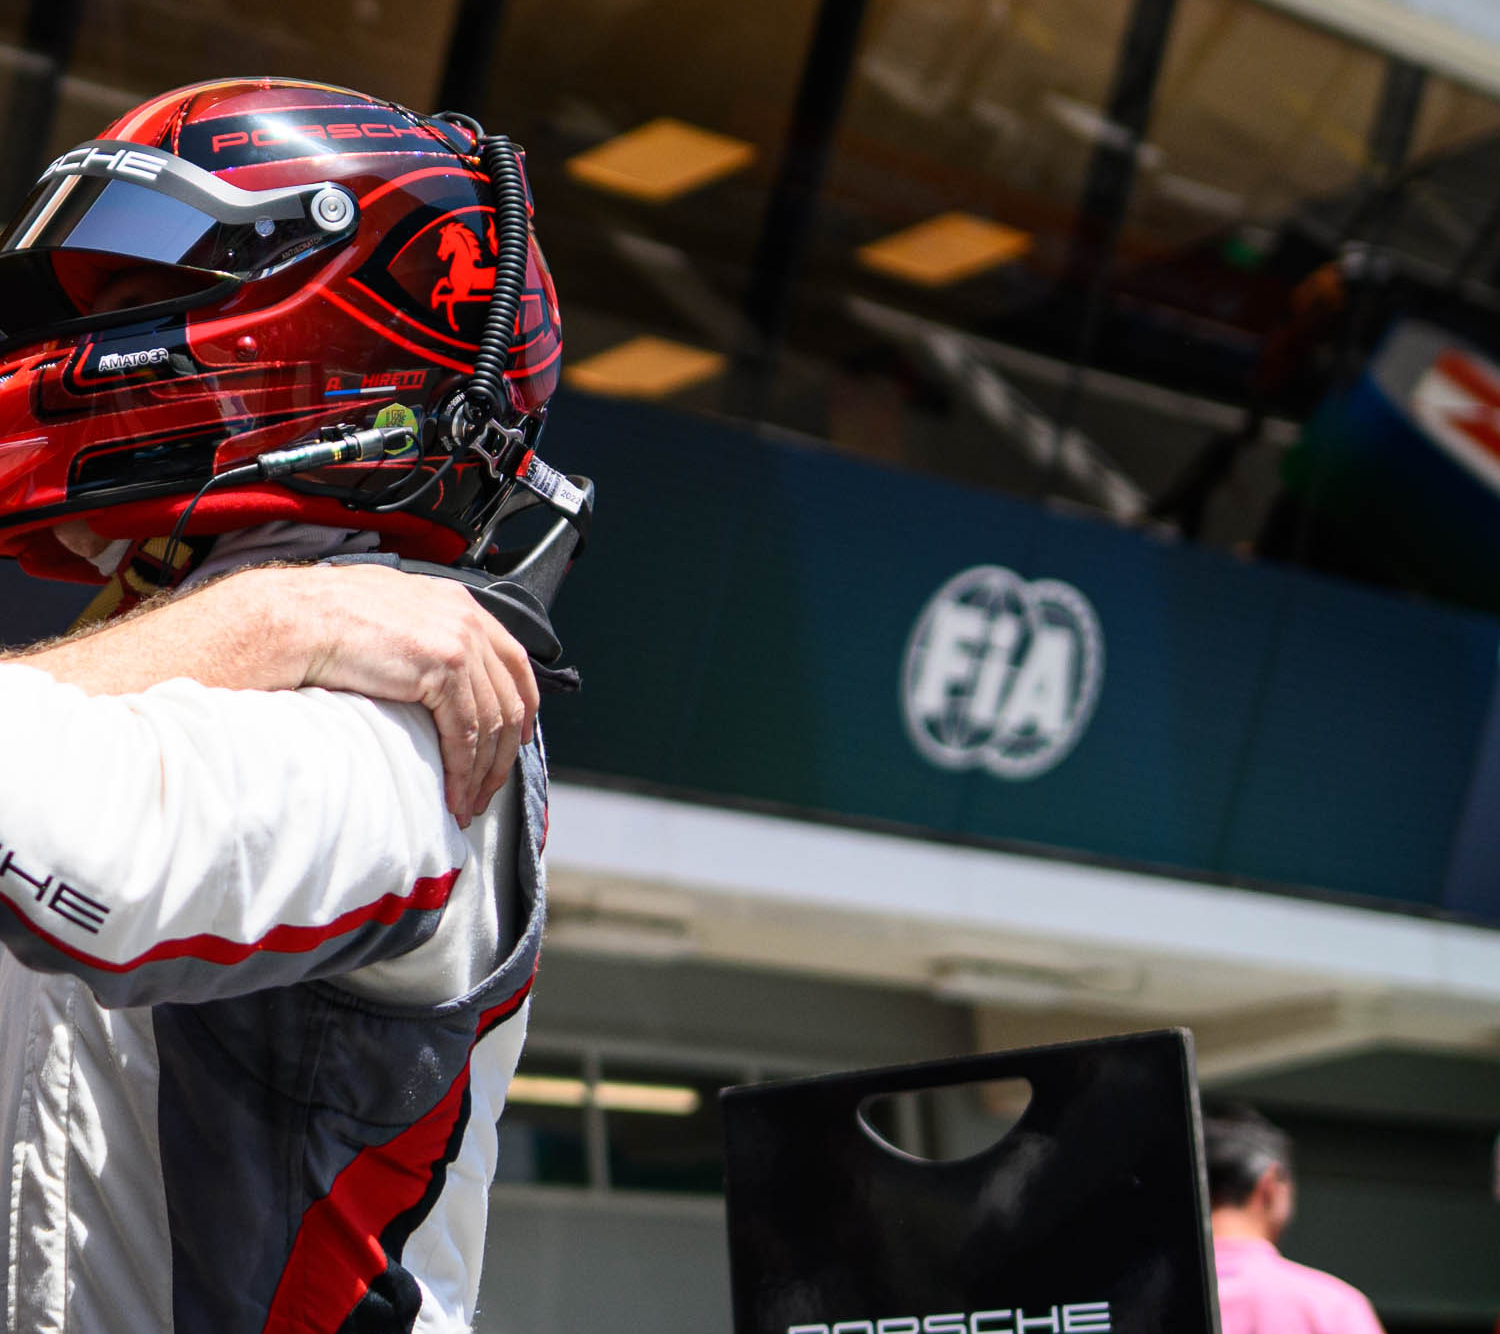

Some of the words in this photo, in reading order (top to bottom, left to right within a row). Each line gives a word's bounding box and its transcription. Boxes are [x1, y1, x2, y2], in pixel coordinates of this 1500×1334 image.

[358, 370, 427, 388] HIRETTI
[560, 488, 582, 505] 2022
[913, 620, 1076, 730] FIA
